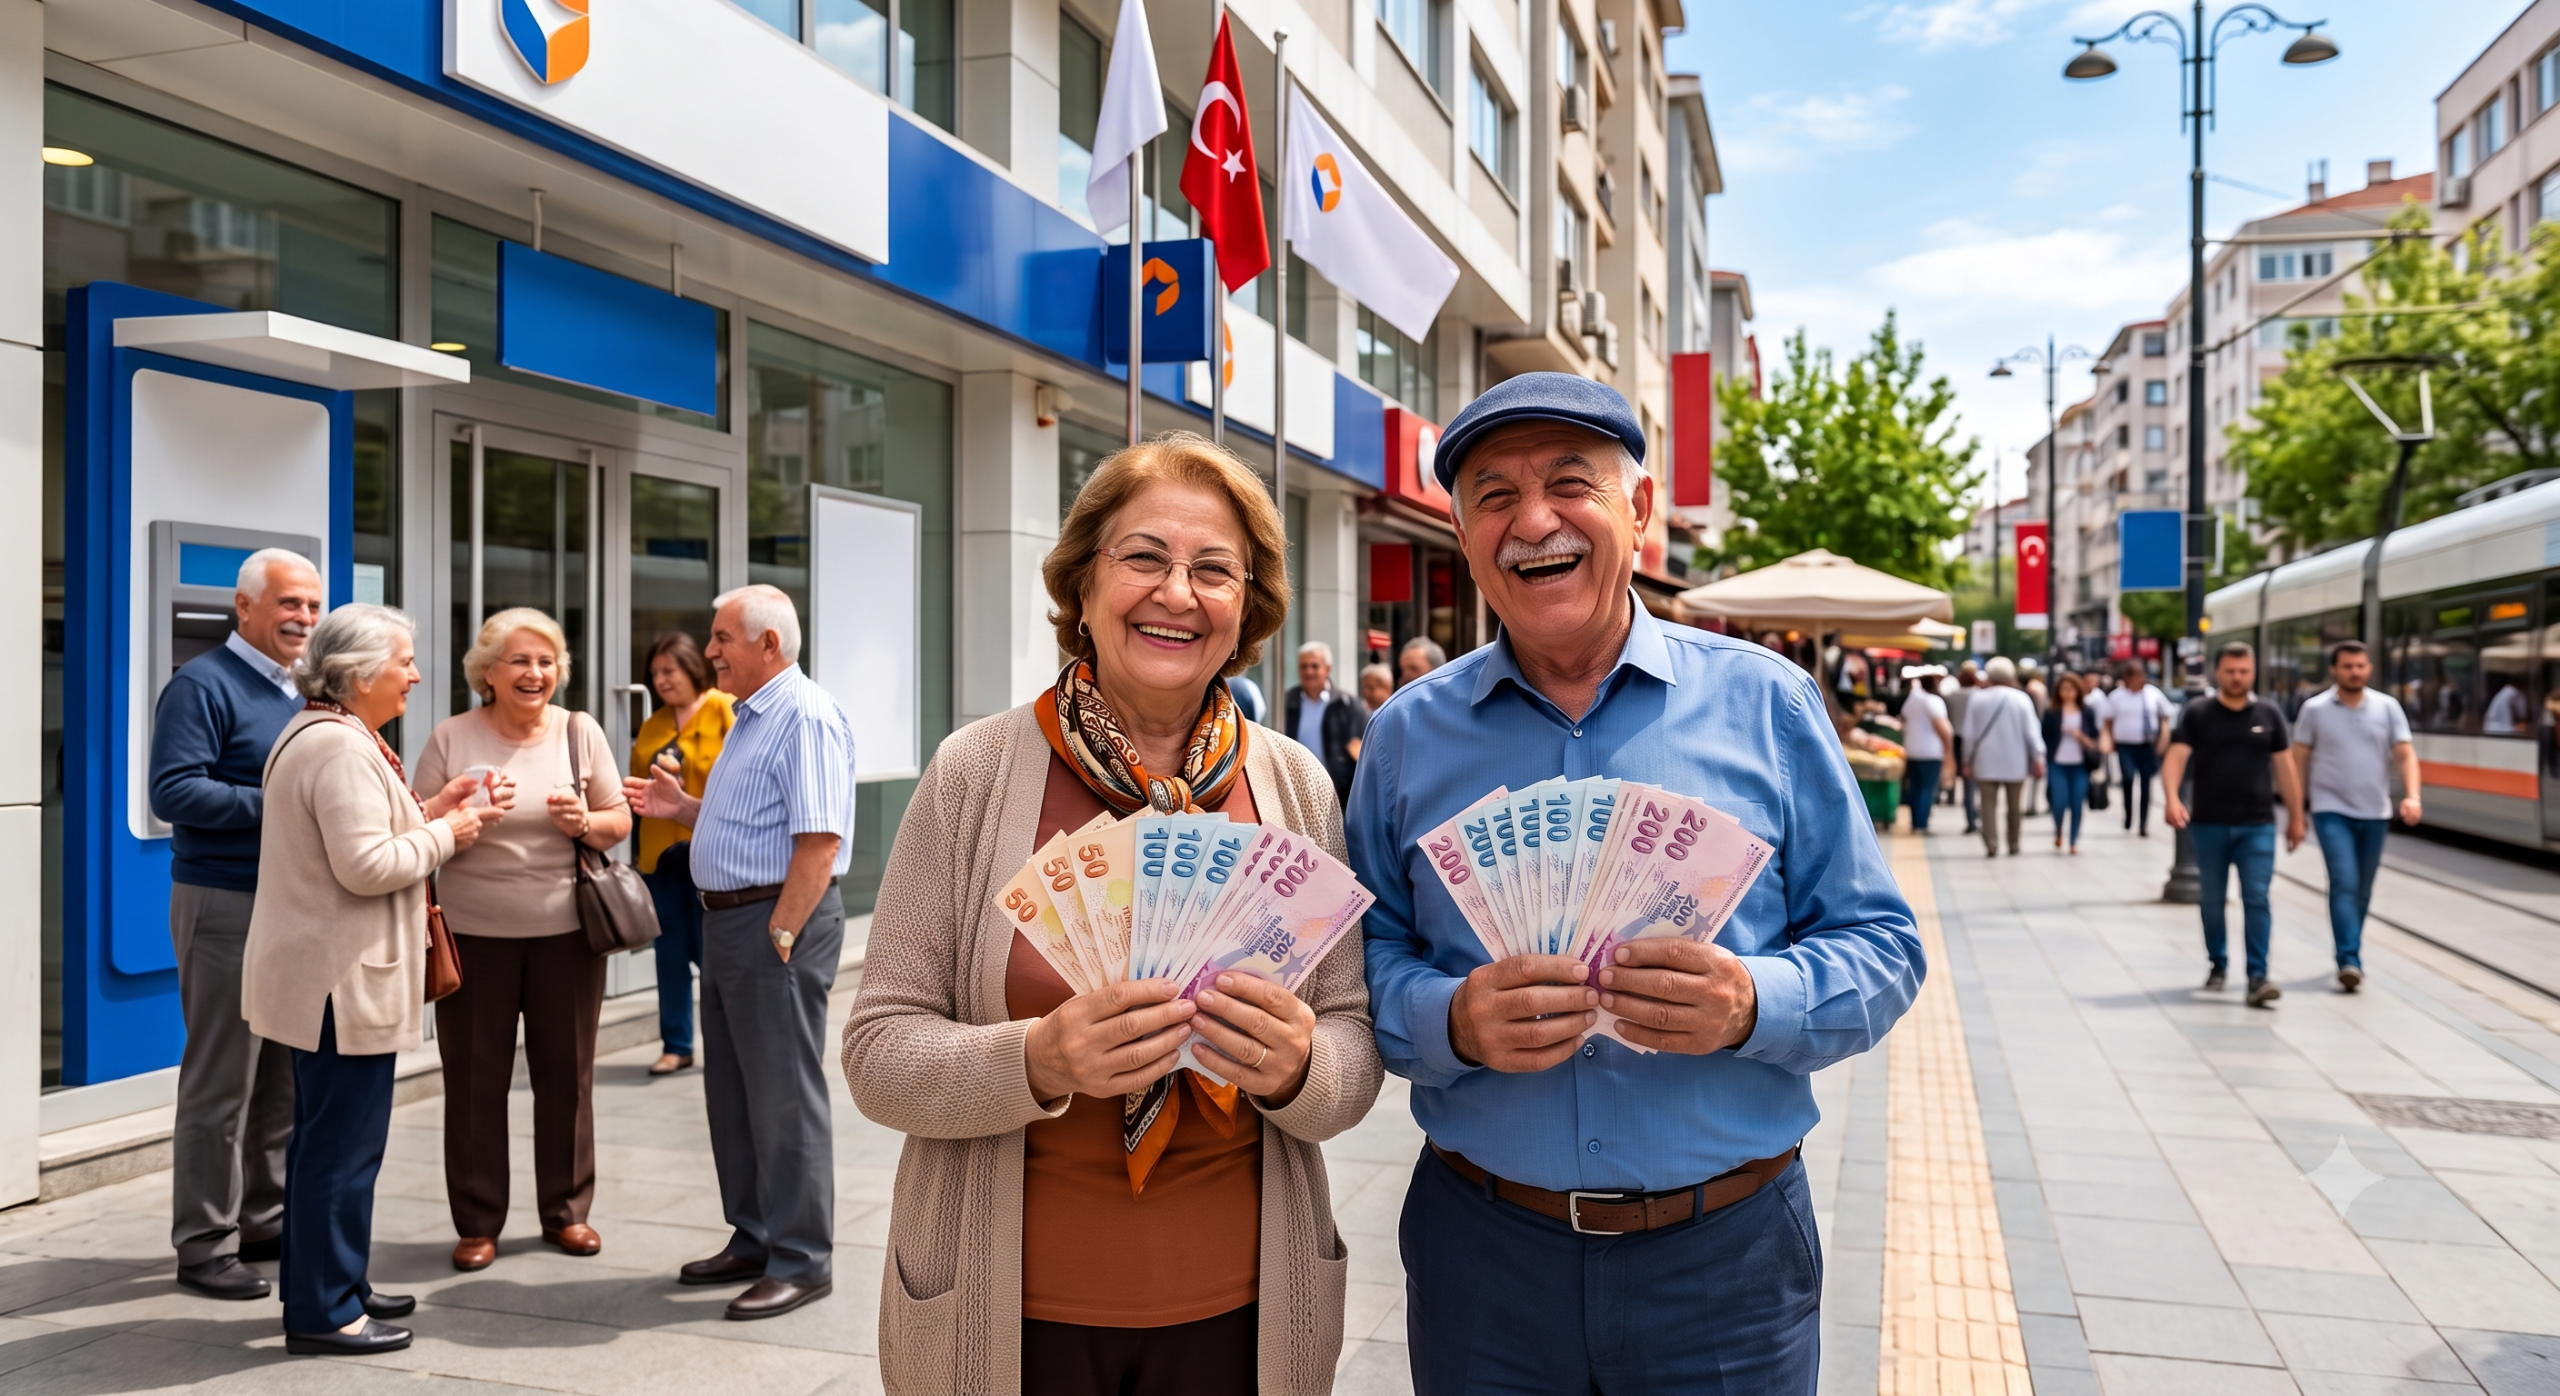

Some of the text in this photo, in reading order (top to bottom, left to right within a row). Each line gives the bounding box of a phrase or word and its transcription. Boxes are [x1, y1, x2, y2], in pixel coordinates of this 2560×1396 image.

[1519, 799, 1540, 847] 100
[1546, 794, 1571, 842] 100
[1587, 794, 1615, 842] 100
[1631, 801, 1670, 854] 200
[1665, 808, 1707, 861] 200
[1043, 856, 1076, 892] 50
[1078, 843, 1109, 878] 50
[1143, 828, 1169, 876] 100
[1171, 829, 1202, 877] 100
[1206, 838, 1241, 884] 100
[1274, 849, 1318, 897] 200
[1428, 836, 1471, 884] 200
[1005, 888, 1037, 922] 50
[1270, 932, 1296, 963] 200
